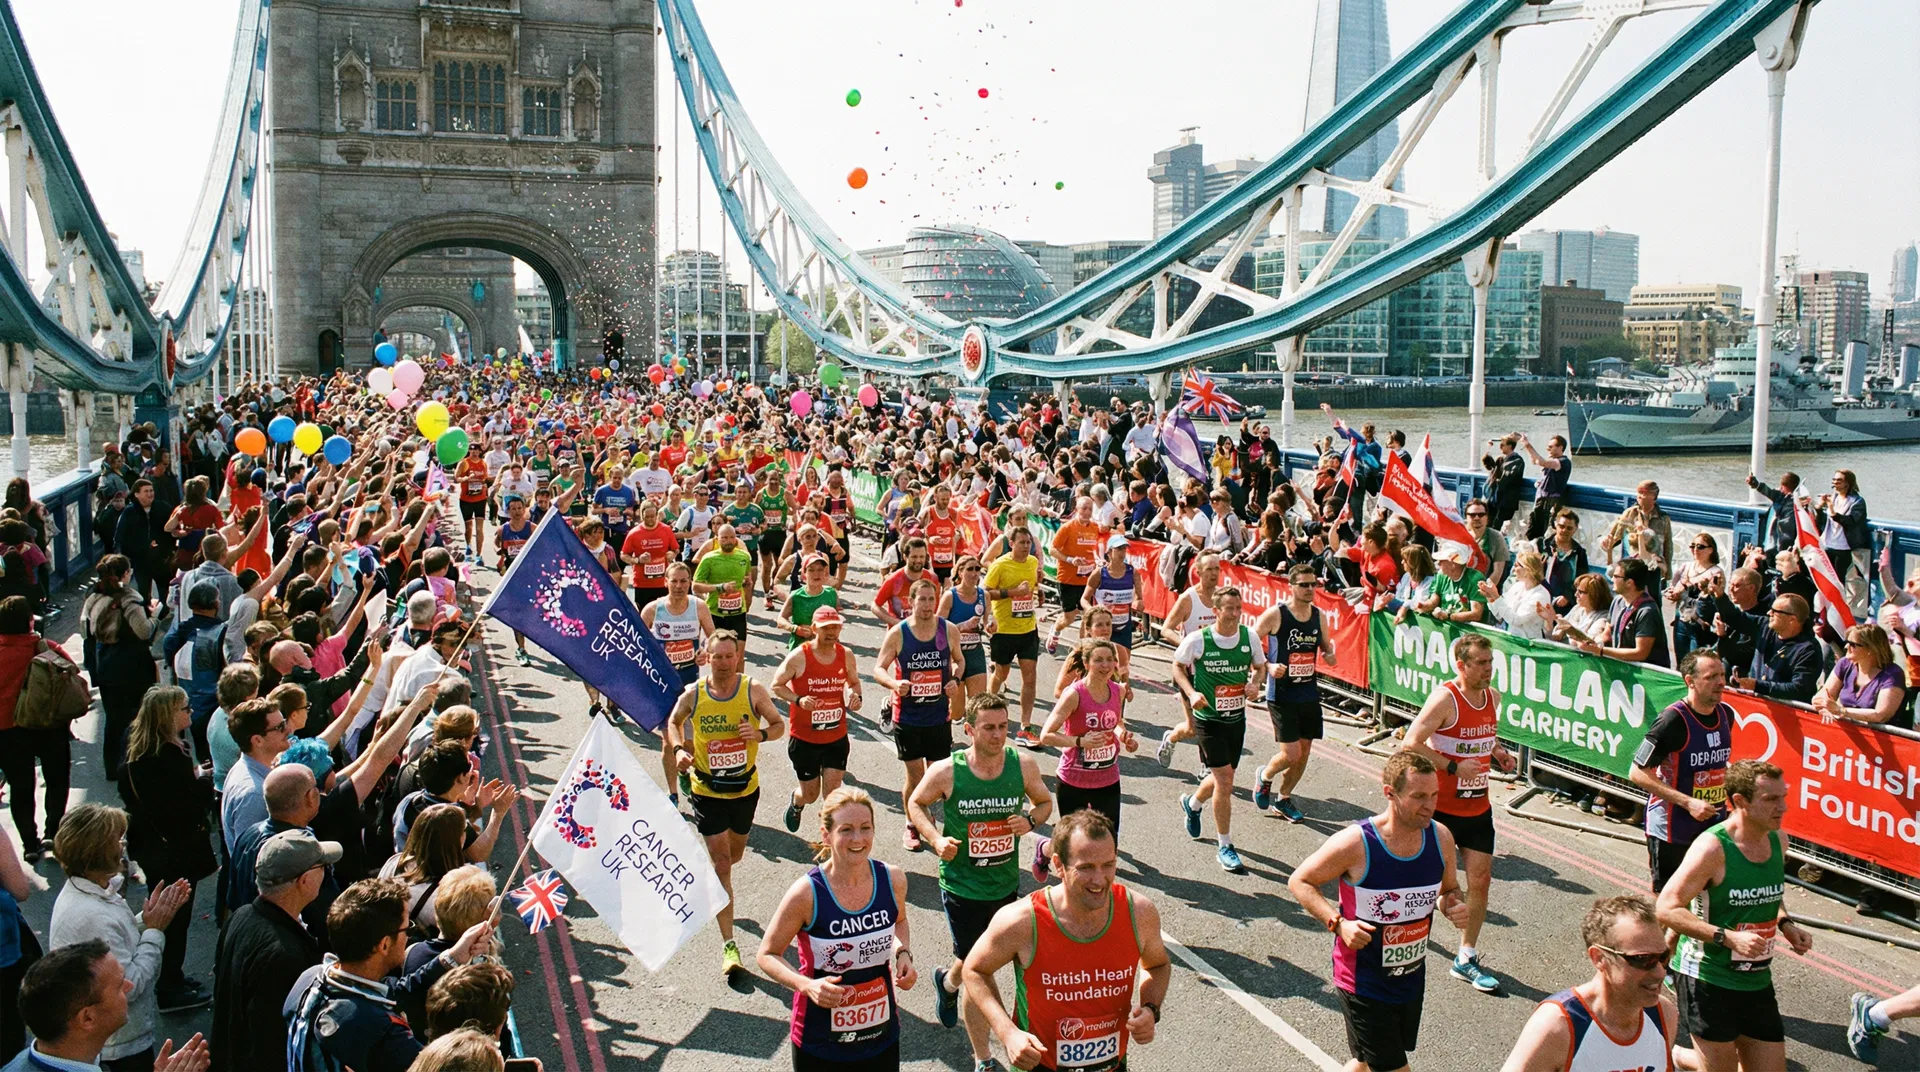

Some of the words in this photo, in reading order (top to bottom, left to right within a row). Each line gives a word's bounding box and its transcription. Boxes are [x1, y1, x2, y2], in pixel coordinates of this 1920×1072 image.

[591, 636, 615, 661] UK
[599, 622, 669, 693] RESEARCH
[911, 651, 941, 661] CANCER
[1506, 703, 1623, 757] CARHERY
[958, 796, 1020, 809] MACMILLAN
[632, 819, 695, 891] CANCER
[971, 837, 1013, 854] 62552
[601, 850, 629, 880] UK
[615, 834, 694, 923] RESEARCH
[829, 909, 890, 936] CANCER
[1041, 972, 1091, 986] British
[1095, 965, 1133, 982] Heart
[1046, 984, 1128, 1002] Foundation
[833, 1000, 887, 1028] 63677
[1060, 1036, 1117, 1062] 38223
